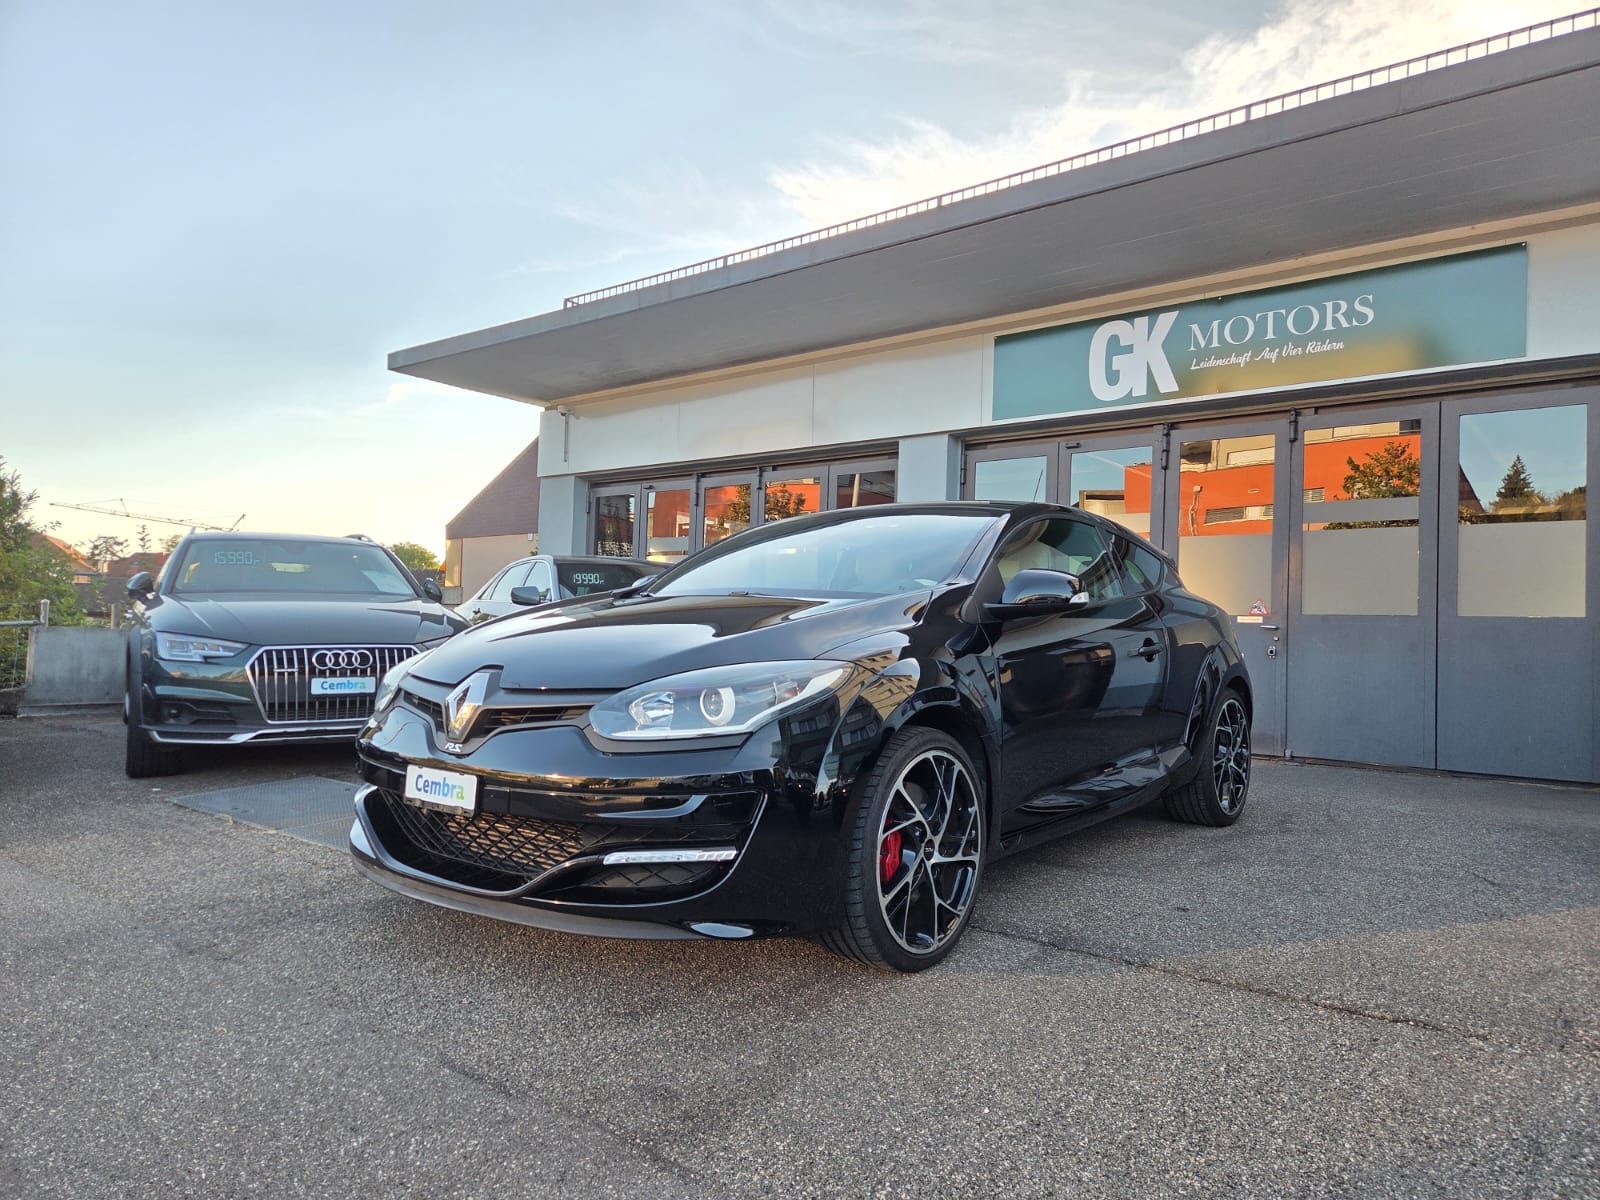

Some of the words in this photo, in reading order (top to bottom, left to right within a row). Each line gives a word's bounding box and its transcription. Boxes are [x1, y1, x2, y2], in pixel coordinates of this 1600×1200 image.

[1089, 311, 1180, 402] GK
[1187, 294, 1375, 351] MOTORS
[1190, 350, 1252, 370] Leidenschaft
[1254, 346, 1280, 363] Auf
[1282, 341, 1303, 357] Vier
[1306, 338, 1345, 354] Rädern
[320, 680, 367, 690] Cembra
[444, 742, 463, 752] RS
[415, 774, 465, 801] Cembra
